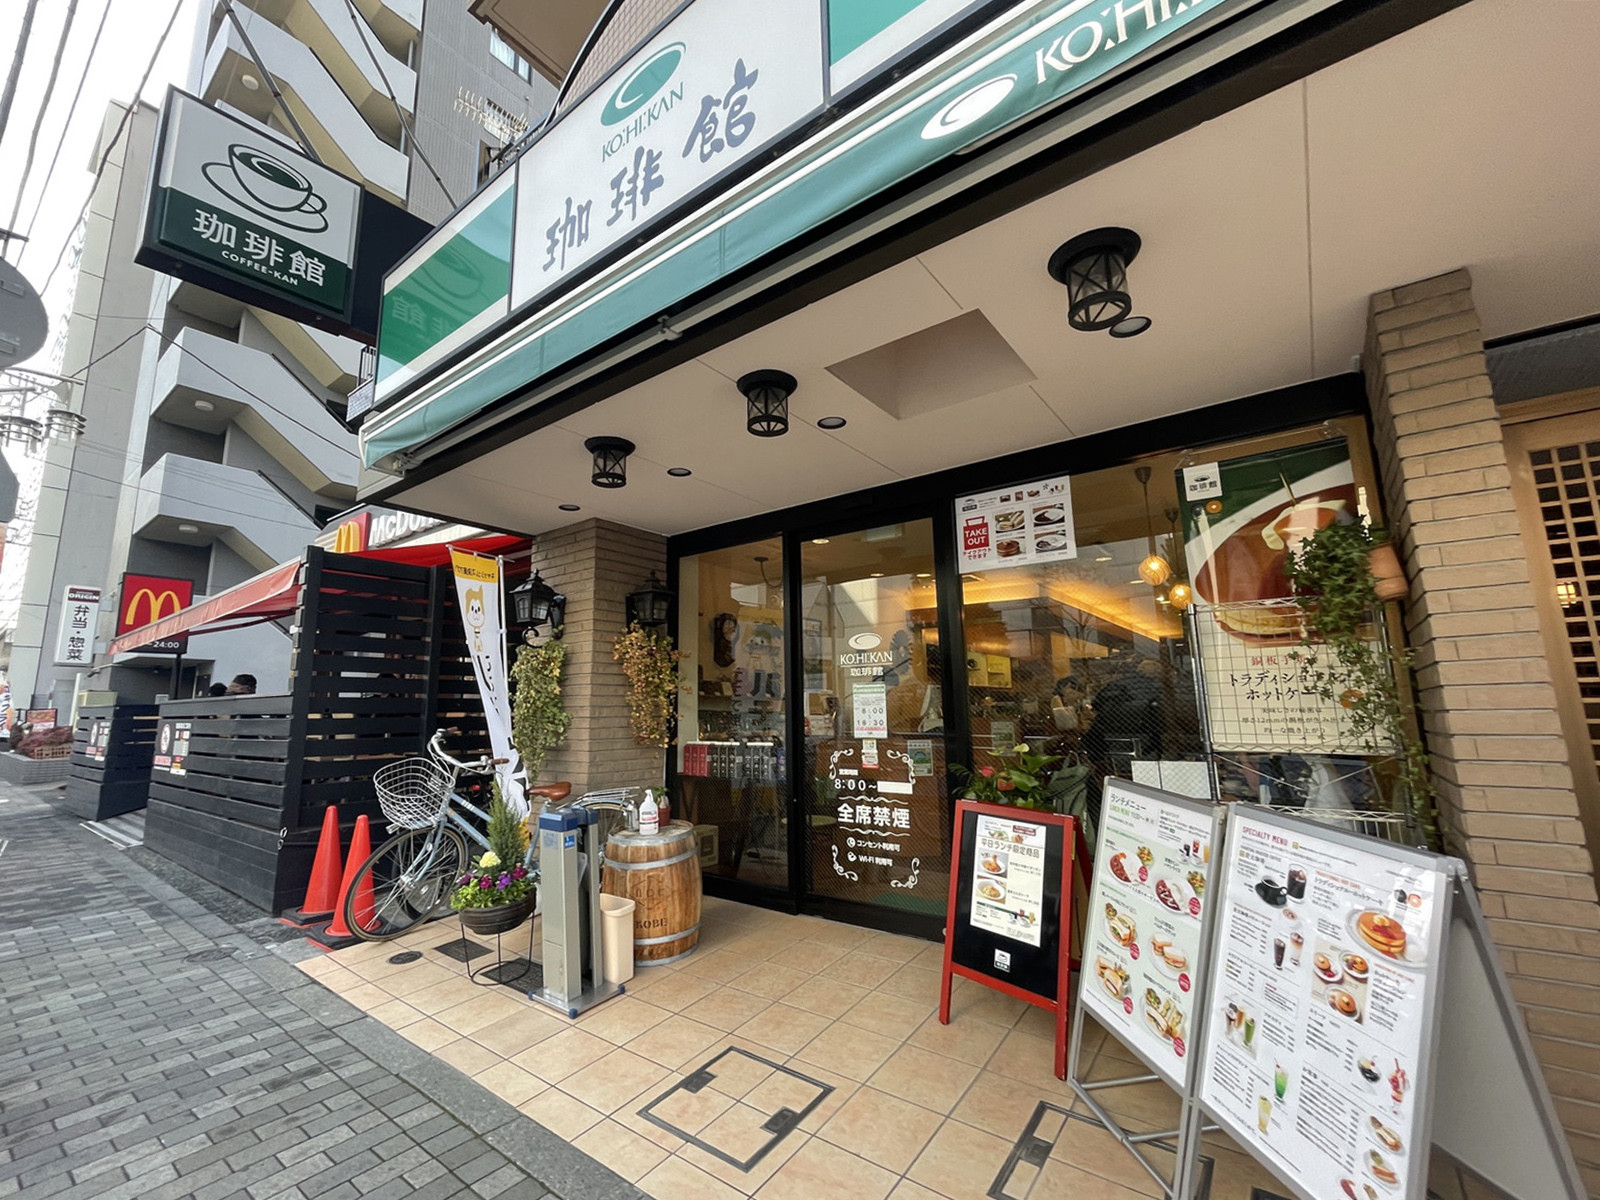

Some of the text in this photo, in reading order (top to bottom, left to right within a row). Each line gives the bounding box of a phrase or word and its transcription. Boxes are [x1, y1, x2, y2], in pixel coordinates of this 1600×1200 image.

[542, 58, 759, 272] 珈琲館
[193, 209, 326, 286] 珈琲館
[222, 250, 299, 286] COFFEE-KAN
[965, 528, 988, 537] TAKE
[967, 536, 986, 546] OUT
[68, 593, 100, 601] ORIGIN
[1246, 687, 1333, 701] ホットケー
[1111, 793, 1146, 810] ランチメニュー
[837, 803, 910, 828] 全席禁煙
[1243, 826, 1288, 846] SPECIALTY MENU
